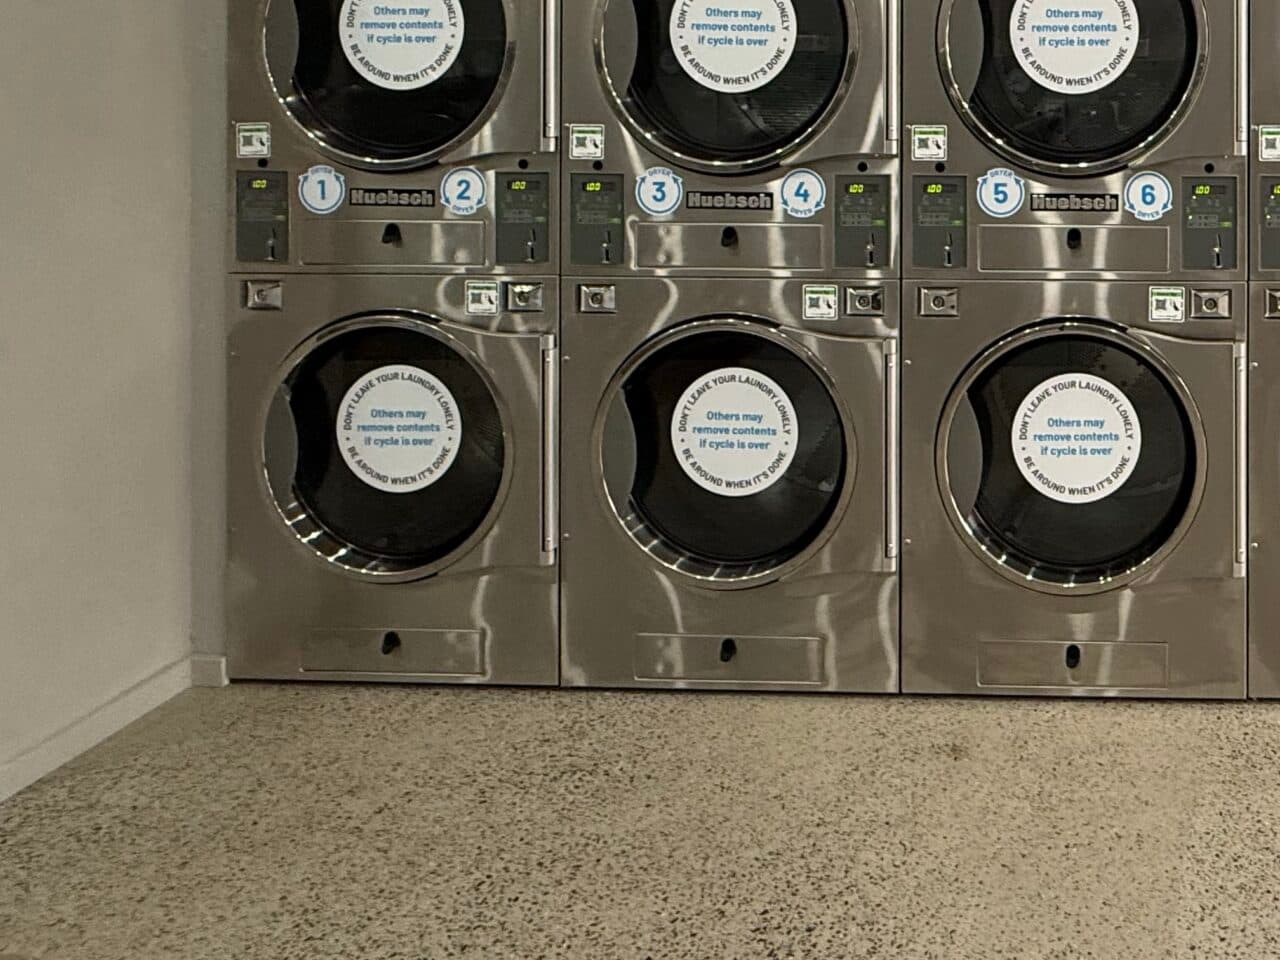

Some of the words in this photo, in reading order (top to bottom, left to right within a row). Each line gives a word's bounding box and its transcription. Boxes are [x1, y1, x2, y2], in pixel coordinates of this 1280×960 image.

[374, 6, 406, 15] Others
[409, 8, 429, 17] may
[705, 8, 739, 17] Others
[741, 10, 762, 20] may
[1045, 9, 1079, 18] Others
[1082, 10, 1103, 20] may
[399, 21, 443, 29] contents
[730, 24, 775, 32] contents
[1072, 24, 1117, 32] contents
[367, 34, 374, 42] if
[376, 34, 402, 44] cycle
[404, 34, 412, 43] is
[698, 35, 705, 44] if
[707, 36, 733, 46] cycle
[736, 37, 744, 45] is
[1039, 37, 1046, 46] if
[1048, 37, 1074, 48] cycle
[1077, 37, 1086, 46] is
[647, 168, 672, 177] DRYER
[989, 170, 1013, 179] DRYER
[316, 179, 326, 201] 1
[456, 179, 471, 201] 2
[652, 181, 666, 203] 3
[794, 181, 810, 203] 4
[993, 182, 1008, 204] 5
[1140, 184, 1156, 205] 6
[351, 190, 433, 205] Huebsch
[688, 193, 772, 208] Huebsch
[1032, 195, 1118, 210] Huebsch
[371, 409, 404, 418] Others
[406, 411, 426, 420] may
[706, 411, 740, 421] Others
[743, 414, 763, 423] may
[396, 424, 440, 432] contents
[1047, 418, 1081, 427] Others
[1084, 420, 1105, 429] may
[732, 427, 777, 435] contents
[364, 437, 371, 445] if
[374, 437, 399, 447] cycle
[402, 437, 410, 445] is
[1074, 433, 1119, 441] contents
[700, 439, 707, 448] if
[709, 440, 734, 450] cycle
[737, 440, 745, 449] is
[1041, 446, 1048, 455] if
[1050, 447, 1076, 457] cycle
[1079, 447, 1088, 455] is
